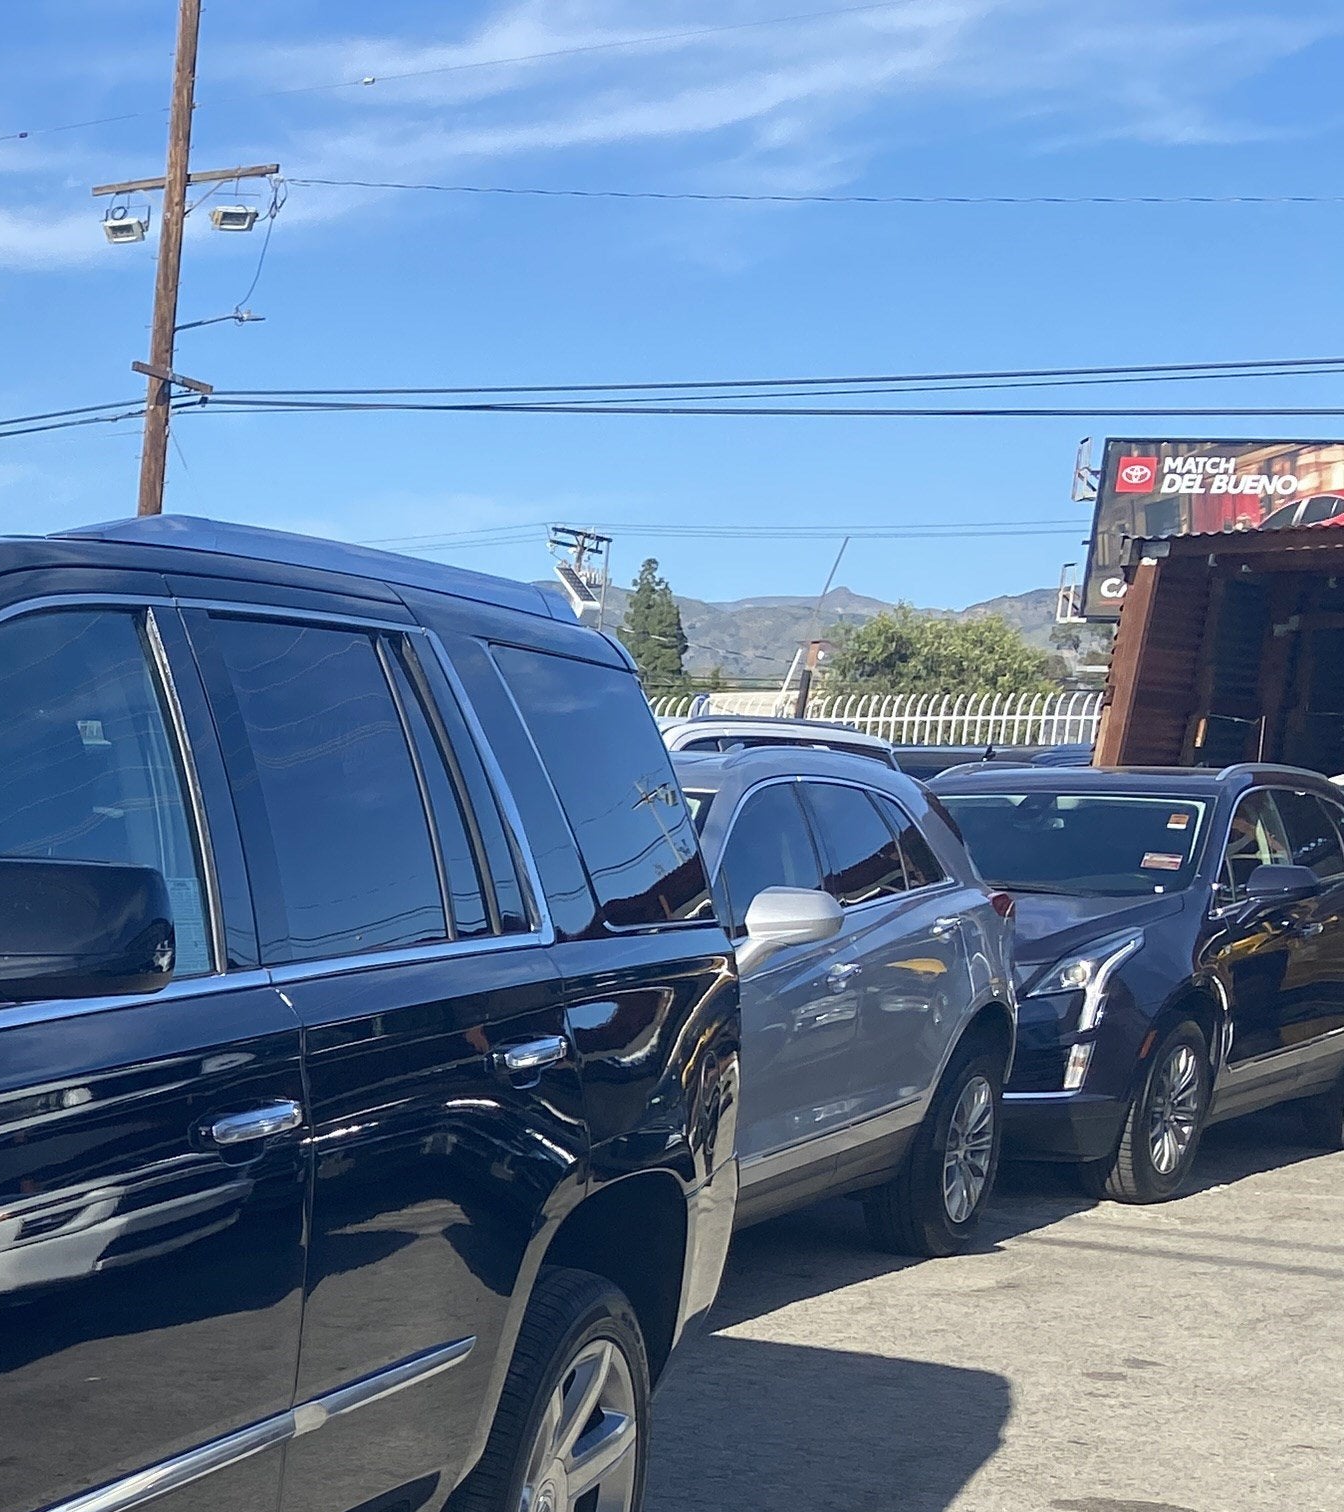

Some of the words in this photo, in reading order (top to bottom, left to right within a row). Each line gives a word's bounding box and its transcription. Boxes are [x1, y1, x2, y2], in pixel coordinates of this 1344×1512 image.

[1163, 456, 1235, 473] MATCH
[1160, 473, 1206, 494] DEL
[1210, 474, 1298, 495] BUENO
